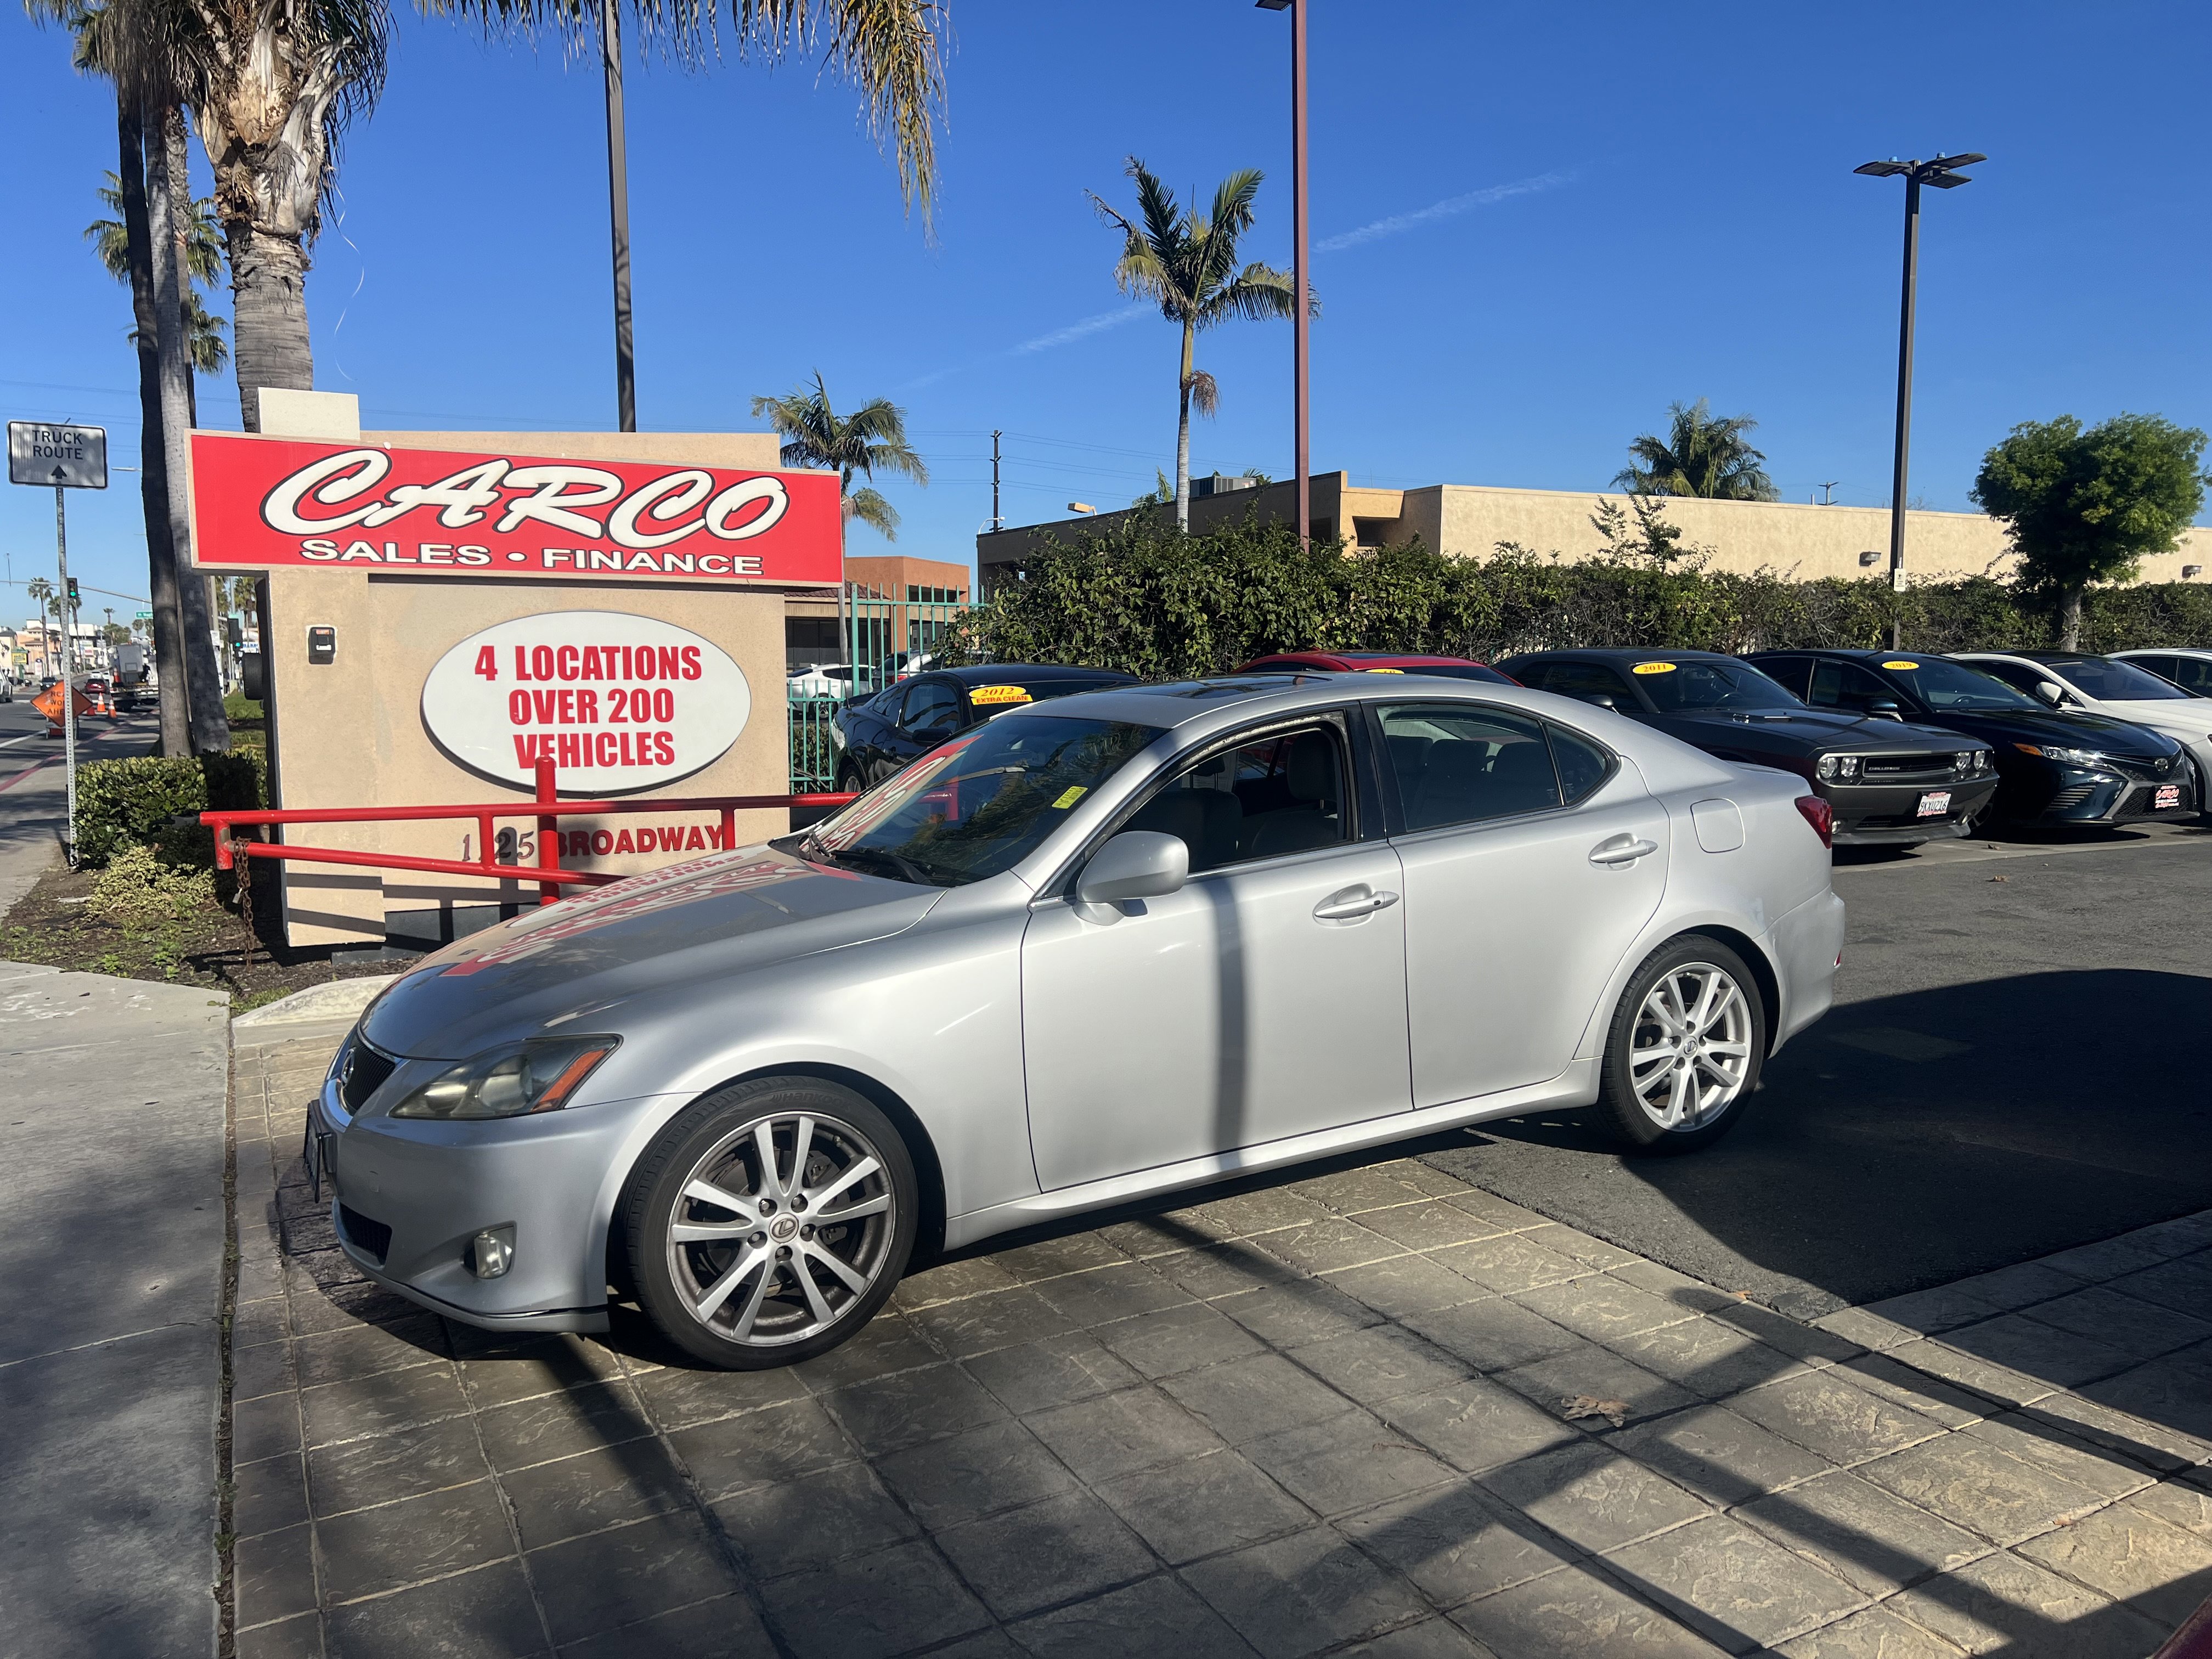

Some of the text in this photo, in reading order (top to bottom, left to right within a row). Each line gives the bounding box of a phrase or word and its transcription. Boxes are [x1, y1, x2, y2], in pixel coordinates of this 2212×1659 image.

[32, 430, 83, 445] TRUCK
[33, 445, 84, 460] ROUTE
[259, 448, 790, 549] CARCO
[299, 538, 764, 577] SALES FINANCE
[475, 645, 702, 681] 4 LOCATIONS
[1643, 663, 1666, 672] 2011
[509, 688, 674, 725] OVER 200
[981, 687, 1014, 696] 2012
[512, 731, 675, 769] VEHICLES
[462, 831, 535, 861] 125
